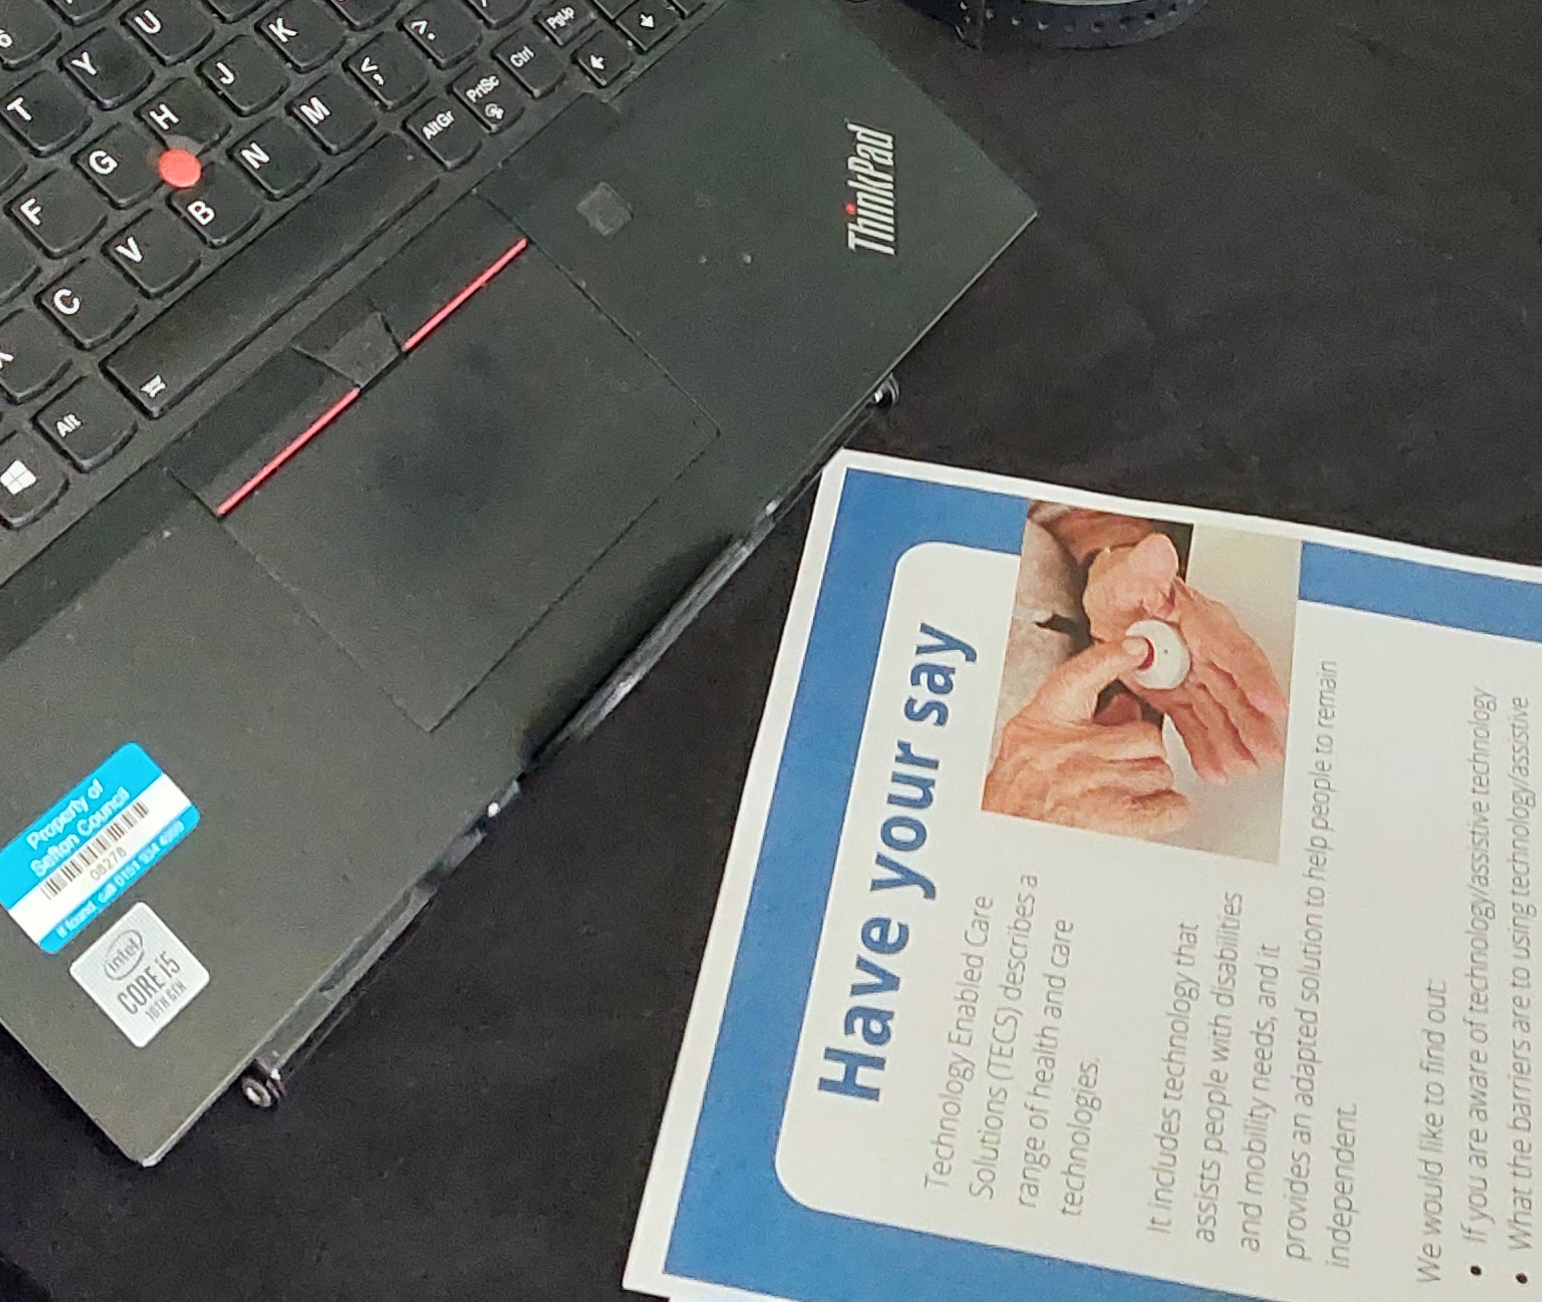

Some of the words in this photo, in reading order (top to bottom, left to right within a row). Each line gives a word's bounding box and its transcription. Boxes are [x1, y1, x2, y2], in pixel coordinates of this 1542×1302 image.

[545, 5, 576, 32] PgUp
[420, 109, 458, 140] AltGr
[465, 75, 500, 105] PrtSc
[845, 120, 895, 255] ThinkPad
[902, 621, 978, 727] say
[1315, 659, 1337, 729] remain
[1314, 733, 1333, 755] to
[26, 795, 89, 849] Property
[87, 777, 104, 799] of
[30, 833, 80, 877] Sefton
[77, 786, 130, 836] Council
[869, 738, 940, 901] your
[1307, 759, 1337, 832] people
[1019, 873, 1038, 890] a
[1301, 833, 1334, 882] help
[963, 895, 994, 948] Care
[1303, 885, 1325, 908] to
[108, 938, 139, 973] intel
[996, 891, 1036, 1002] describes
[1049, 918, 1074, 969] care
[1170, 921, 1199, 967] that
[1208, 890, 1243, 1008] disabilities
[1255, 942, 1280, 959] it
[1295, 912, 1323, 1005] solution
[118, 965, 165, 1014] CORE
[155, 951, 180, 978] i5
[816, 916, 910, 1102] Have
[946, 951, 985, 1048] Enabled
[1041, 971, 1066, 1020] and
[1253, 961, 1279, 1009] and
[1424, 978, 1447, 1024] out:
[980, 1004, 1024, 1081] (TECS)
[1025, 1024, 1059, 1099] health
[1160, 970, 1201, 1101] technology
[1206, 1012, 1232, 1062] with
[1248, 1015, 1279, 1092] needs,
[1288, 1005, 1322, 1107] adapted
[1418, 1027, 1446, 1075] find
[922, 1050, 977, 1188] Technology
[1022, 1100, 1049, 1130] of
[1201, 1068, 1233, 1156] people
[1291, 1112, 1312, 1146] an
[1422, 1080, 1445, 1106] to
[967, 1085, 1008, 1200] Solutions
[1058, 1057, 1102, 1216] technologies.
[1147, 1106, 1181, 1211] includes
[1239, 1095, 1277, 1196] mobility
[1417, 1111, 1444, 1154] like
[1016, 1134, 1051, 1208] range
[1192, 1157, 1221, 1243] assists
[1282, 1149, 1312, 1261] provides
[1324, 1102, 1359, 1269] independent.
[1416, 1157, 1444, 1236] would
[1145, 1215, 1172, 1234] It
[1235, 1199, 1263, 1252] and
[1415, 1242, 1442, 1283] We
